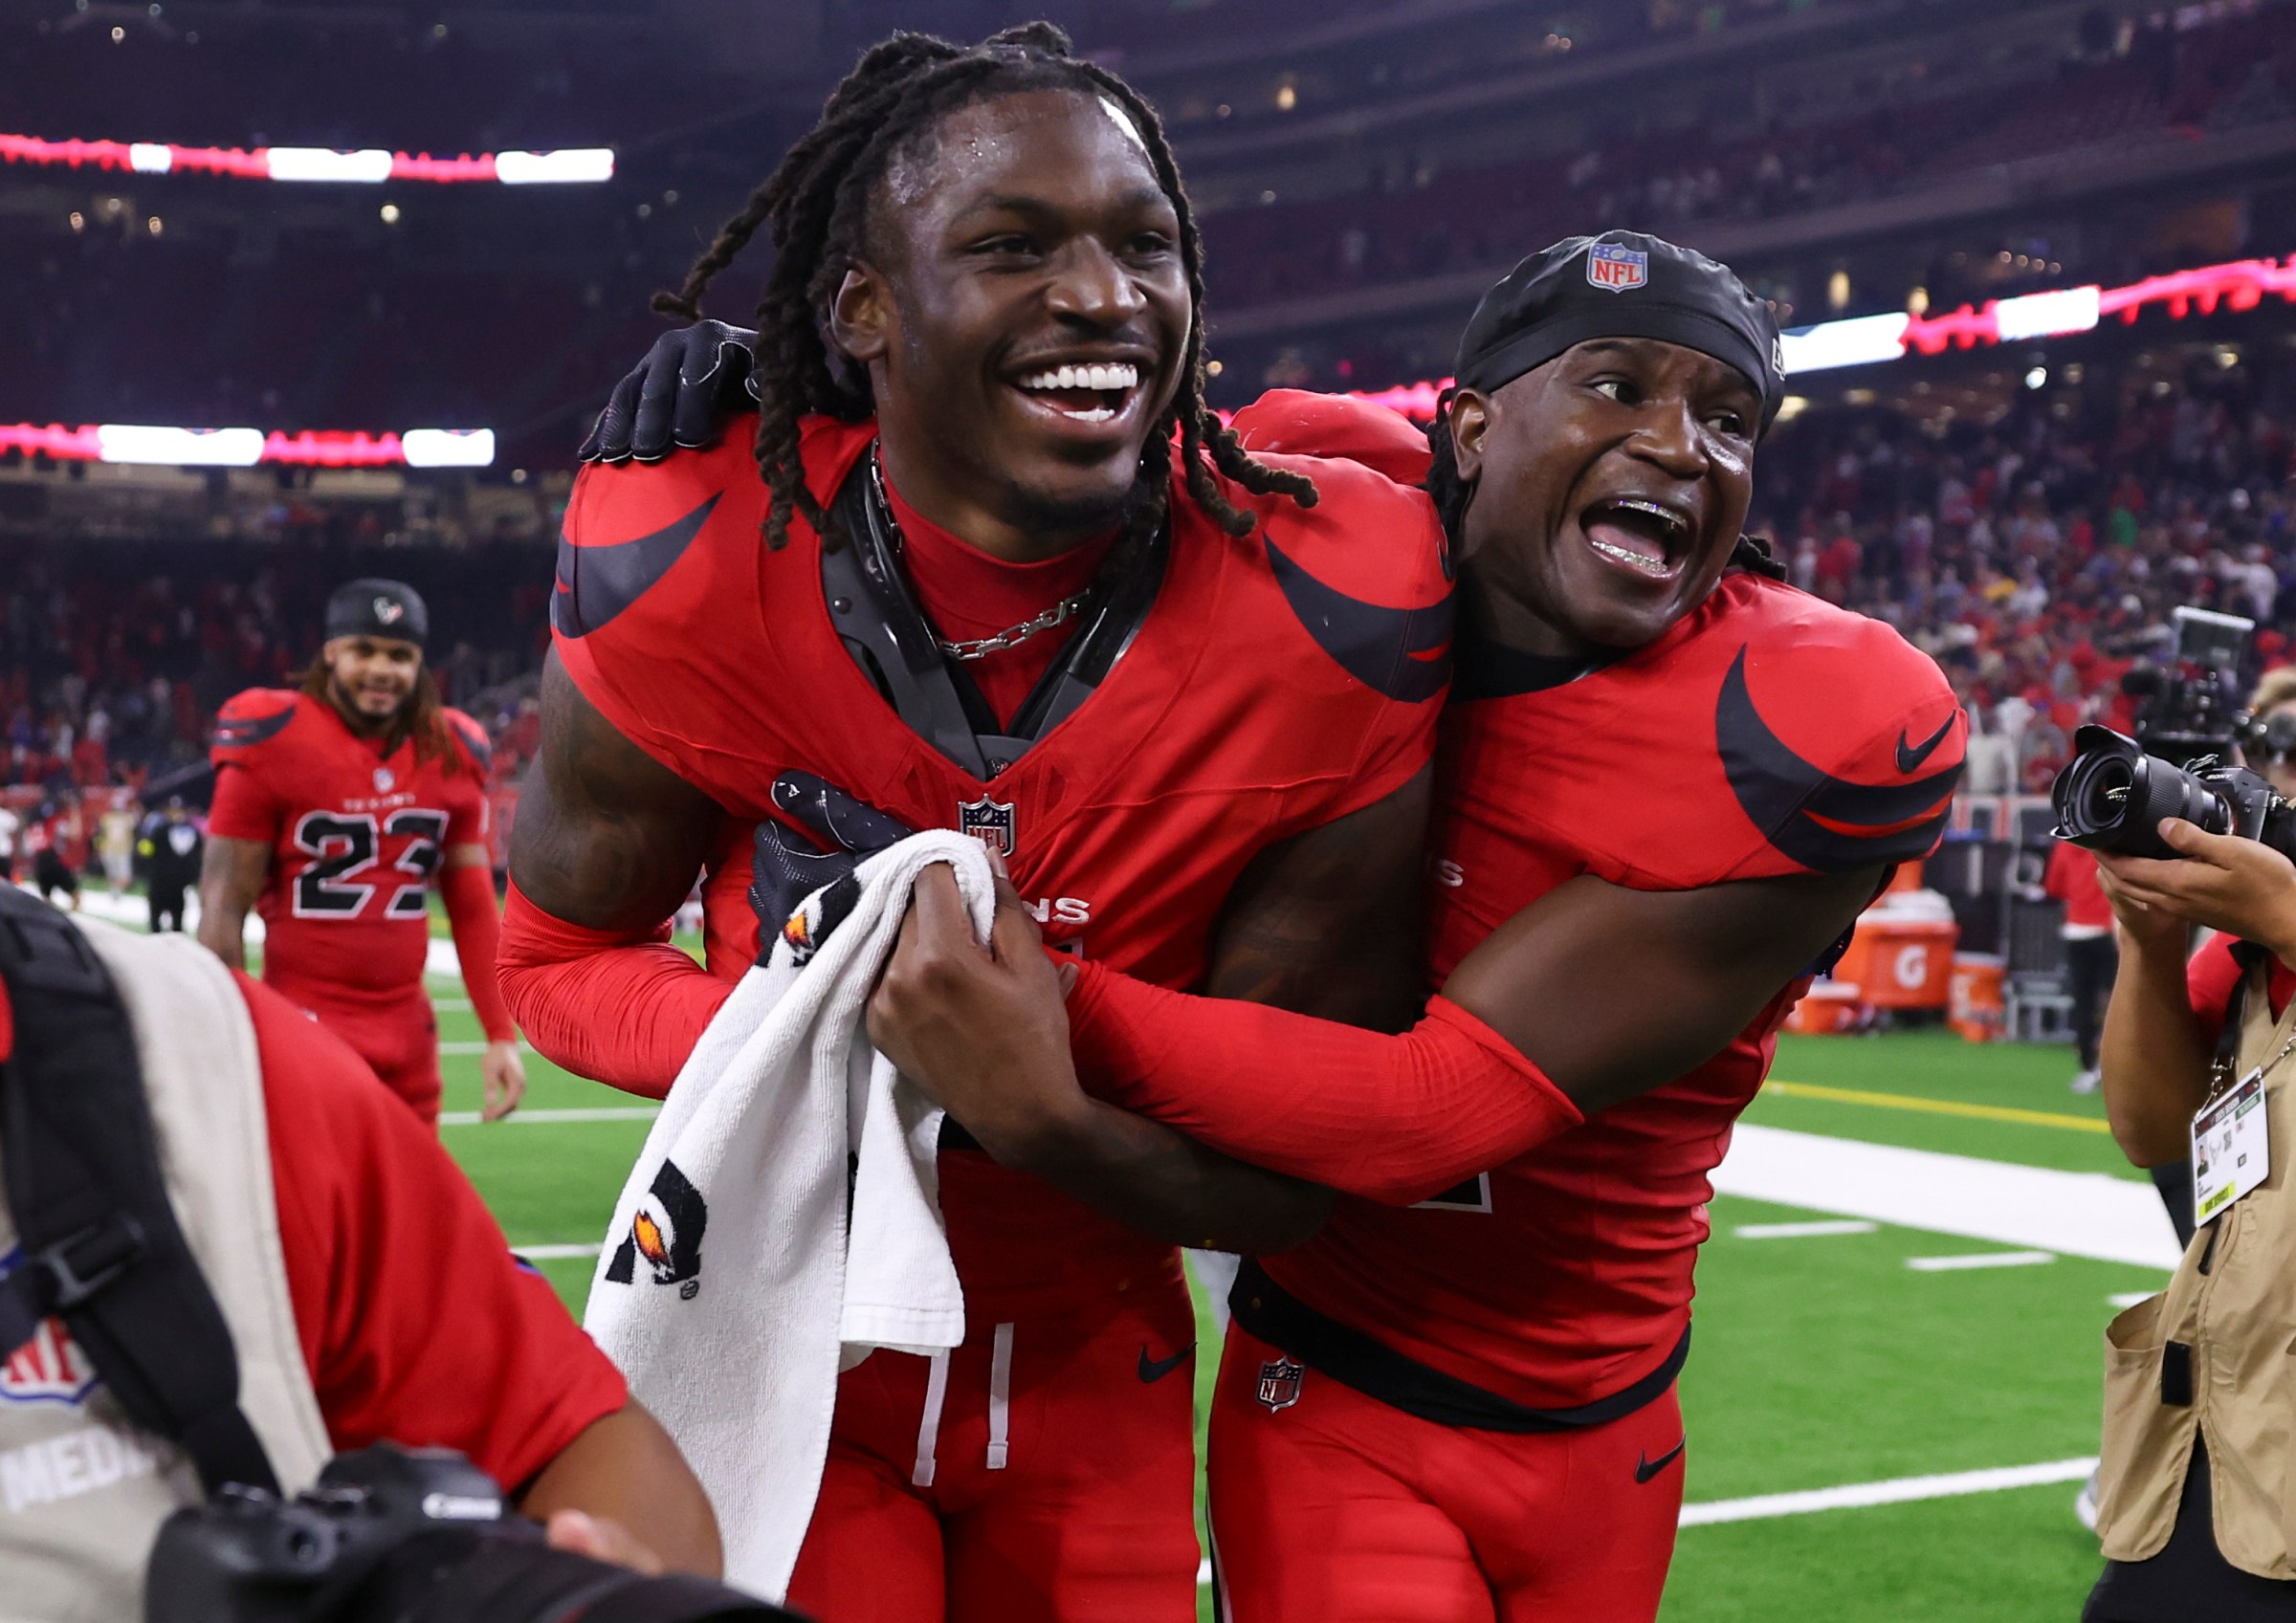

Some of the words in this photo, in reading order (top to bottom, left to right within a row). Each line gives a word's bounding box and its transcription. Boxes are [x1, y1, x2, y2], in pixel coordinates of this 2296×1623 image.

[1594, 259, 1642, 285] NFL
[293, 808, 450, 918] 23
[1893, 943, 1929, 990] G
